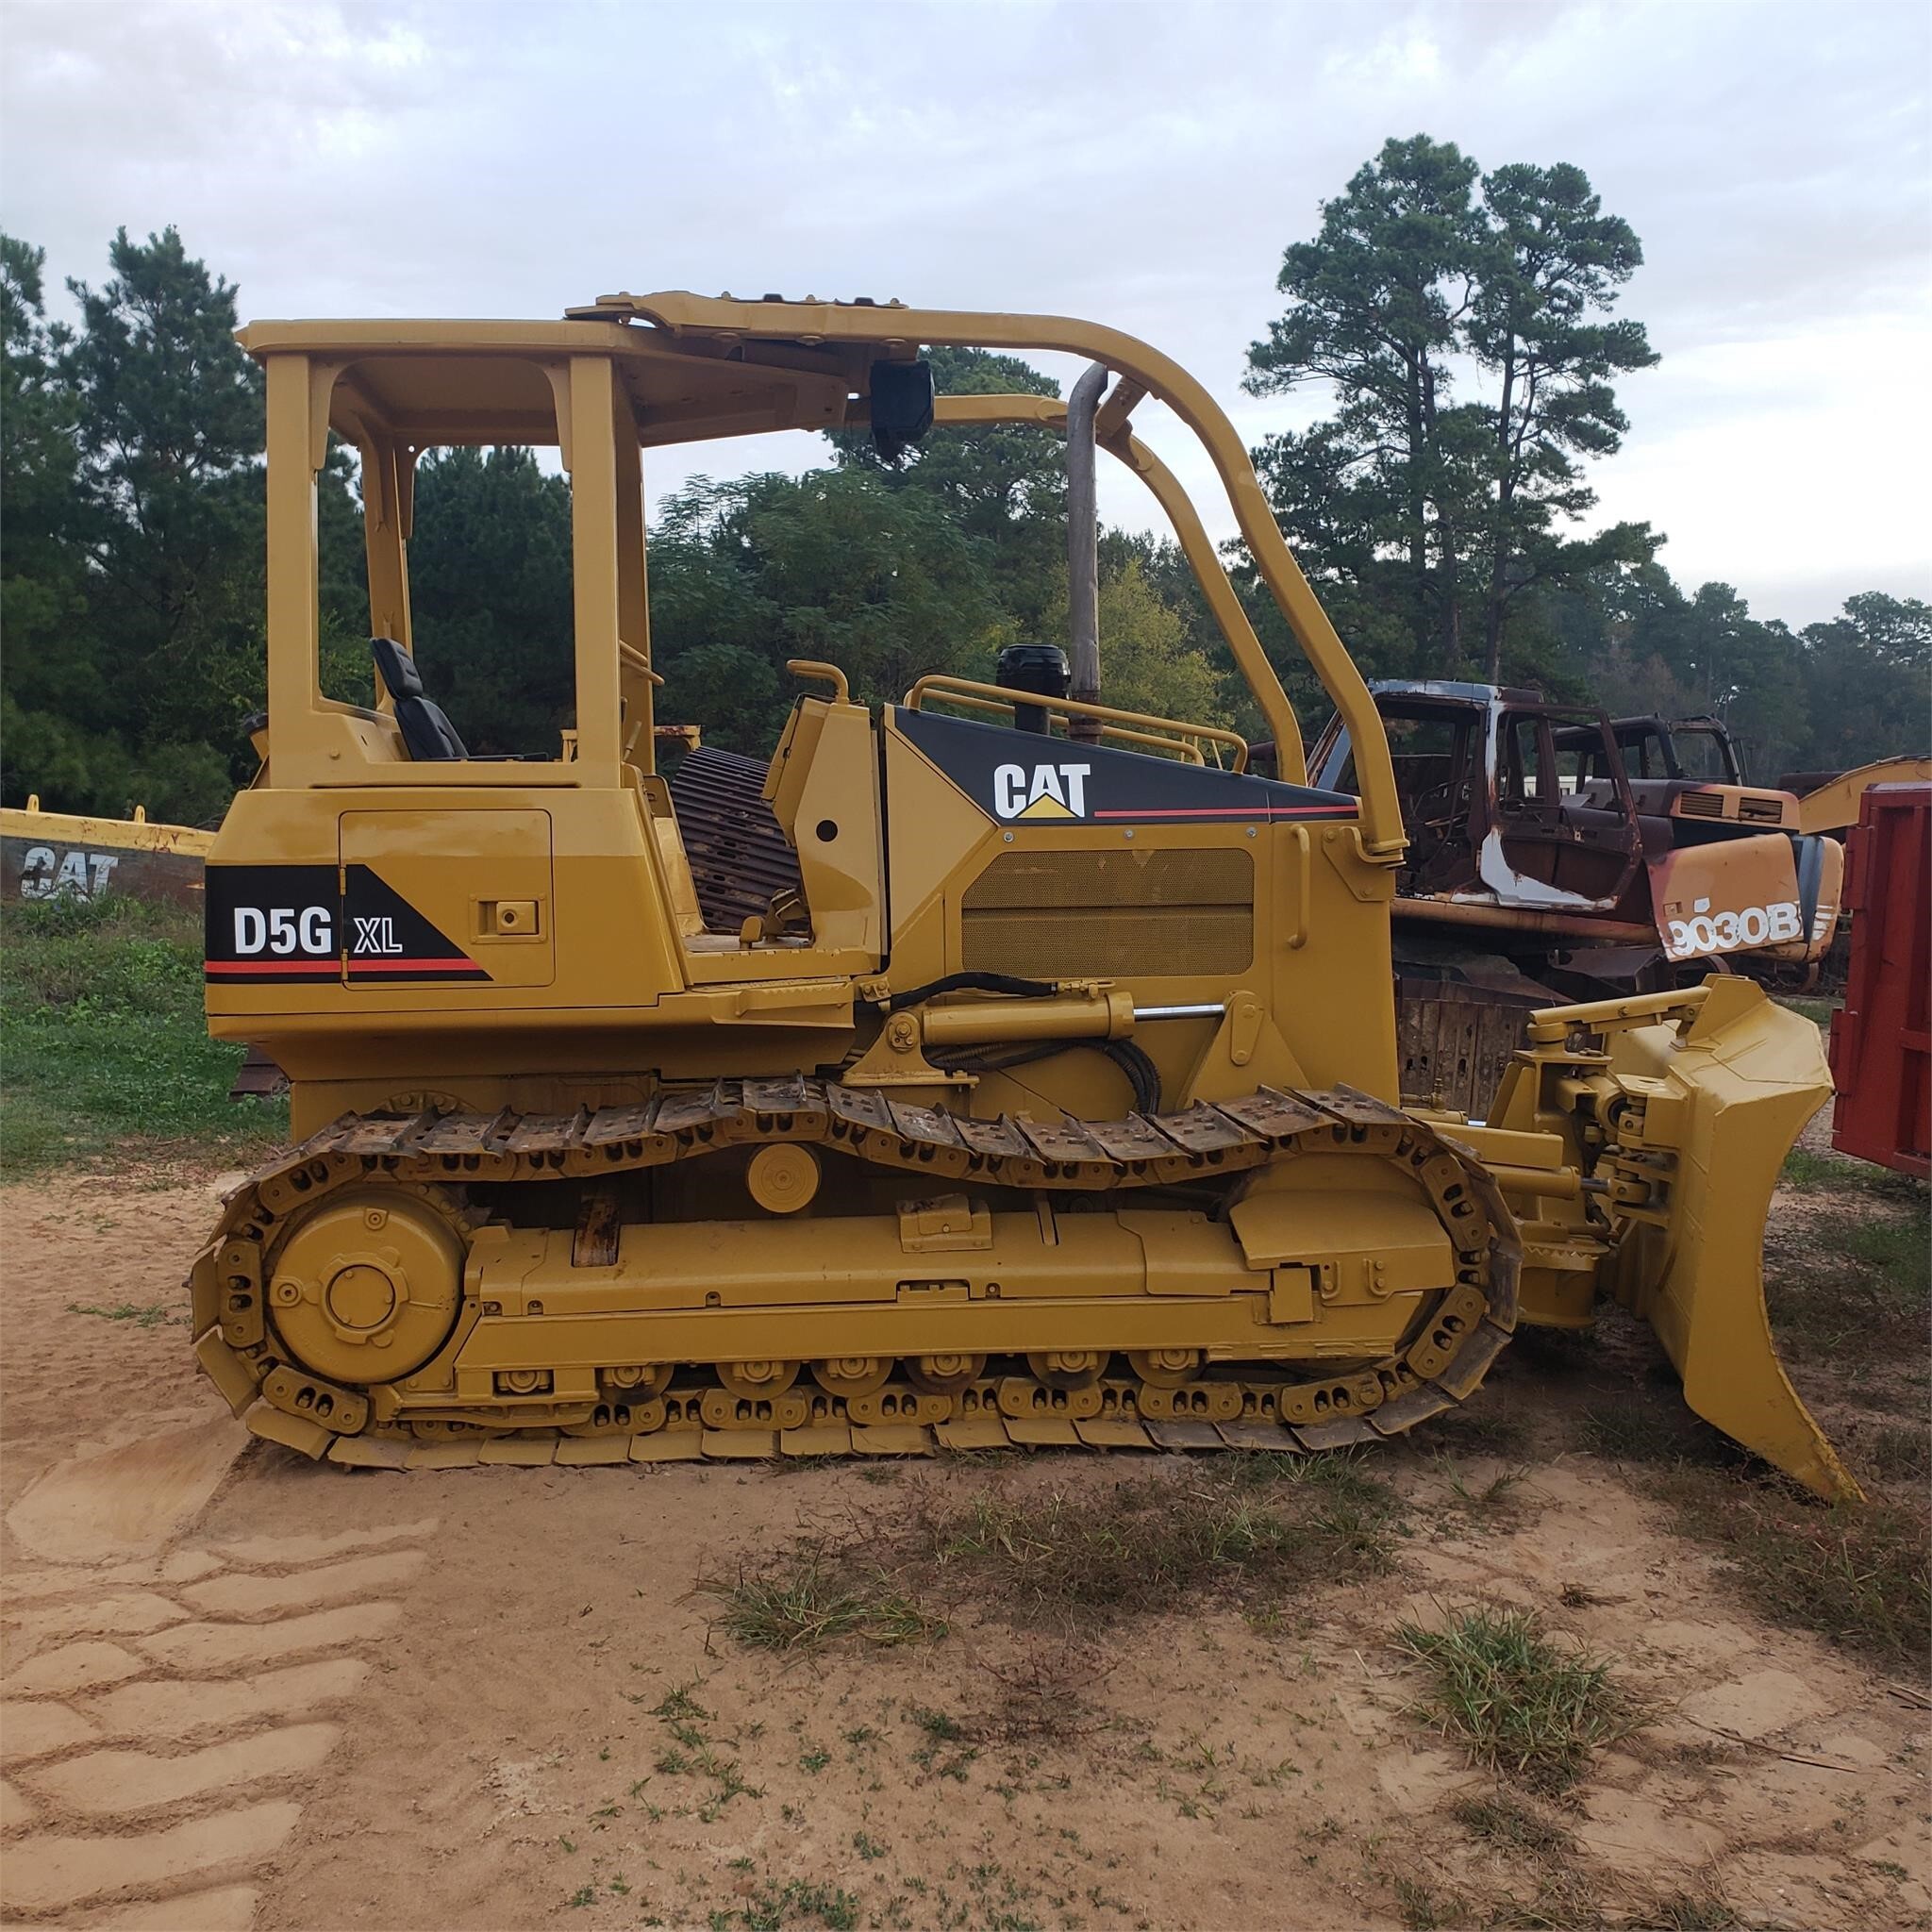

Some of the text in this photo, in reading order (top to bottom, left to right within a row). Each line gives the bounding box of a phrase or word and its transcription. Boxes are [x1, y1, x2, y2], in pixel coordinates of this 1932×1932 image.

[993, 763, 1091, 819] CAT
[20, 846, 119, 902] CAT
[234, 906, 403, 954] D5G XL
[1668, 902, 1801, 957] 9030B
